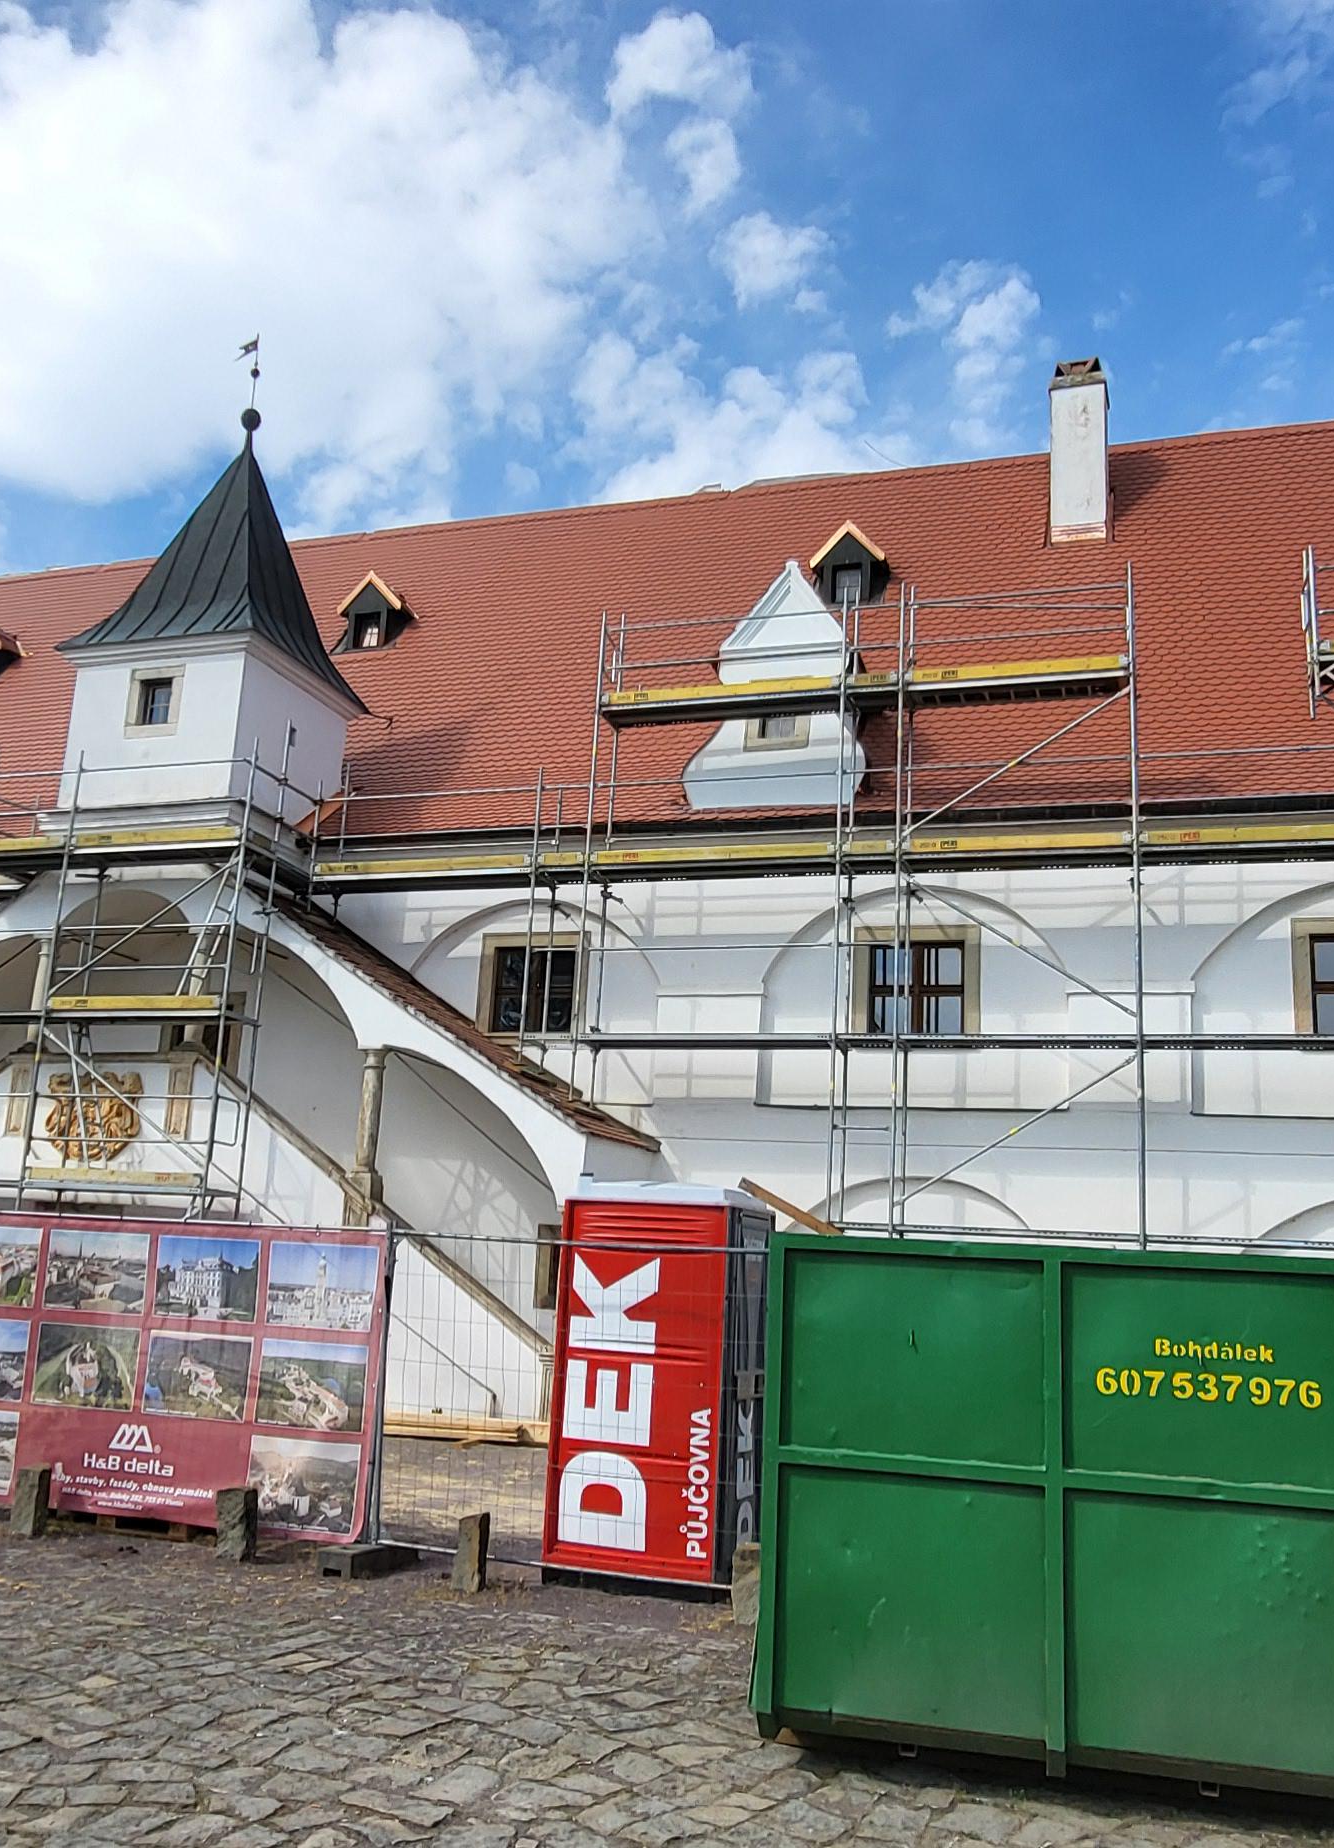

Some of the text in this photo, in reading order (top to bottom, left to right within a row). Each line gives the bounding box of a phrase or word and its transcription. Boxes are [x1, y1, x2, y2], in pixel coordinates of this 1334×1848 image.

[83, 1452, 175, 1477] H&B delta
[557, 1252, 661, 1552] DEK
[736, 1400, 755, 1546] DEK
[142, 1481, 175, 1494] obnova
[679, 1408, 712, 1559] PŮJČOVNA
